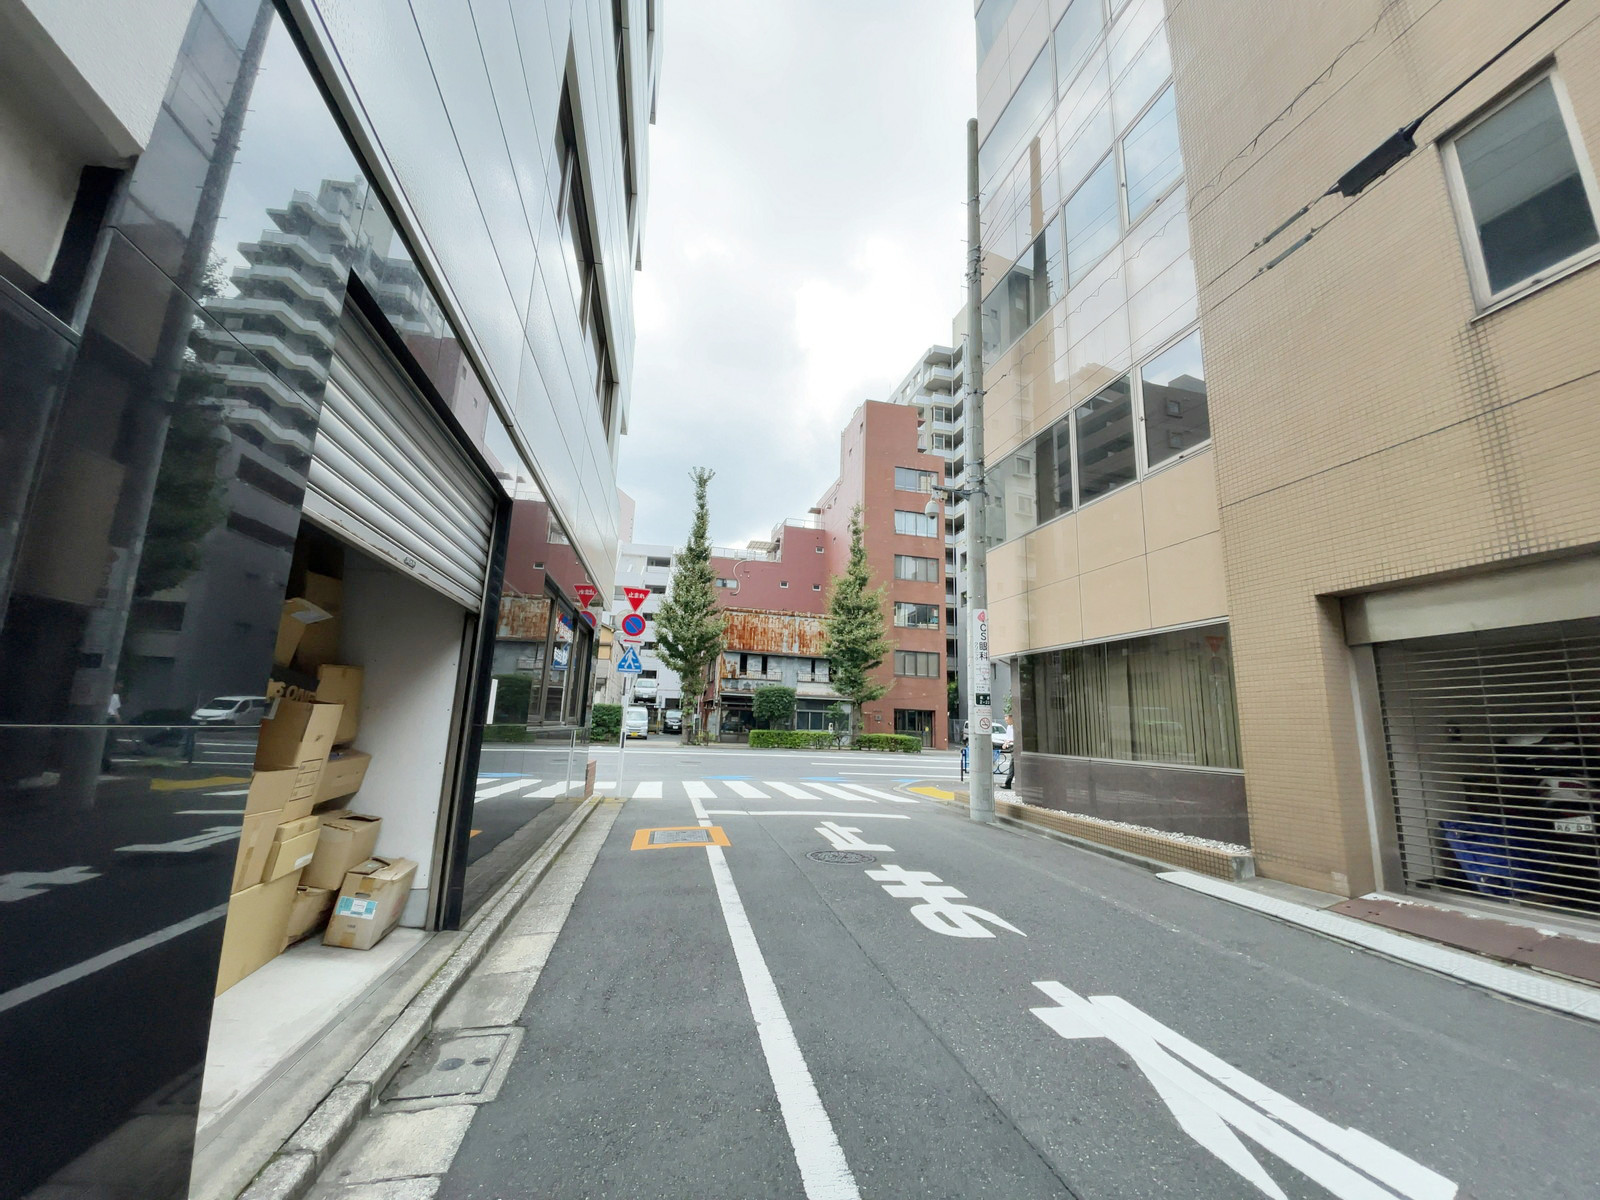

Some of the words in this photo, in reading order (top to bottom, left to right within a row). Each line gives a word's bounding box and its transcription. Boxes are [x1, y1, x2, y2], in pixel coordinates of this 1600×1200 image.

[979, 623, 988, 662] CS眼科
[814, 821, 1458, 1200] 止まれ
